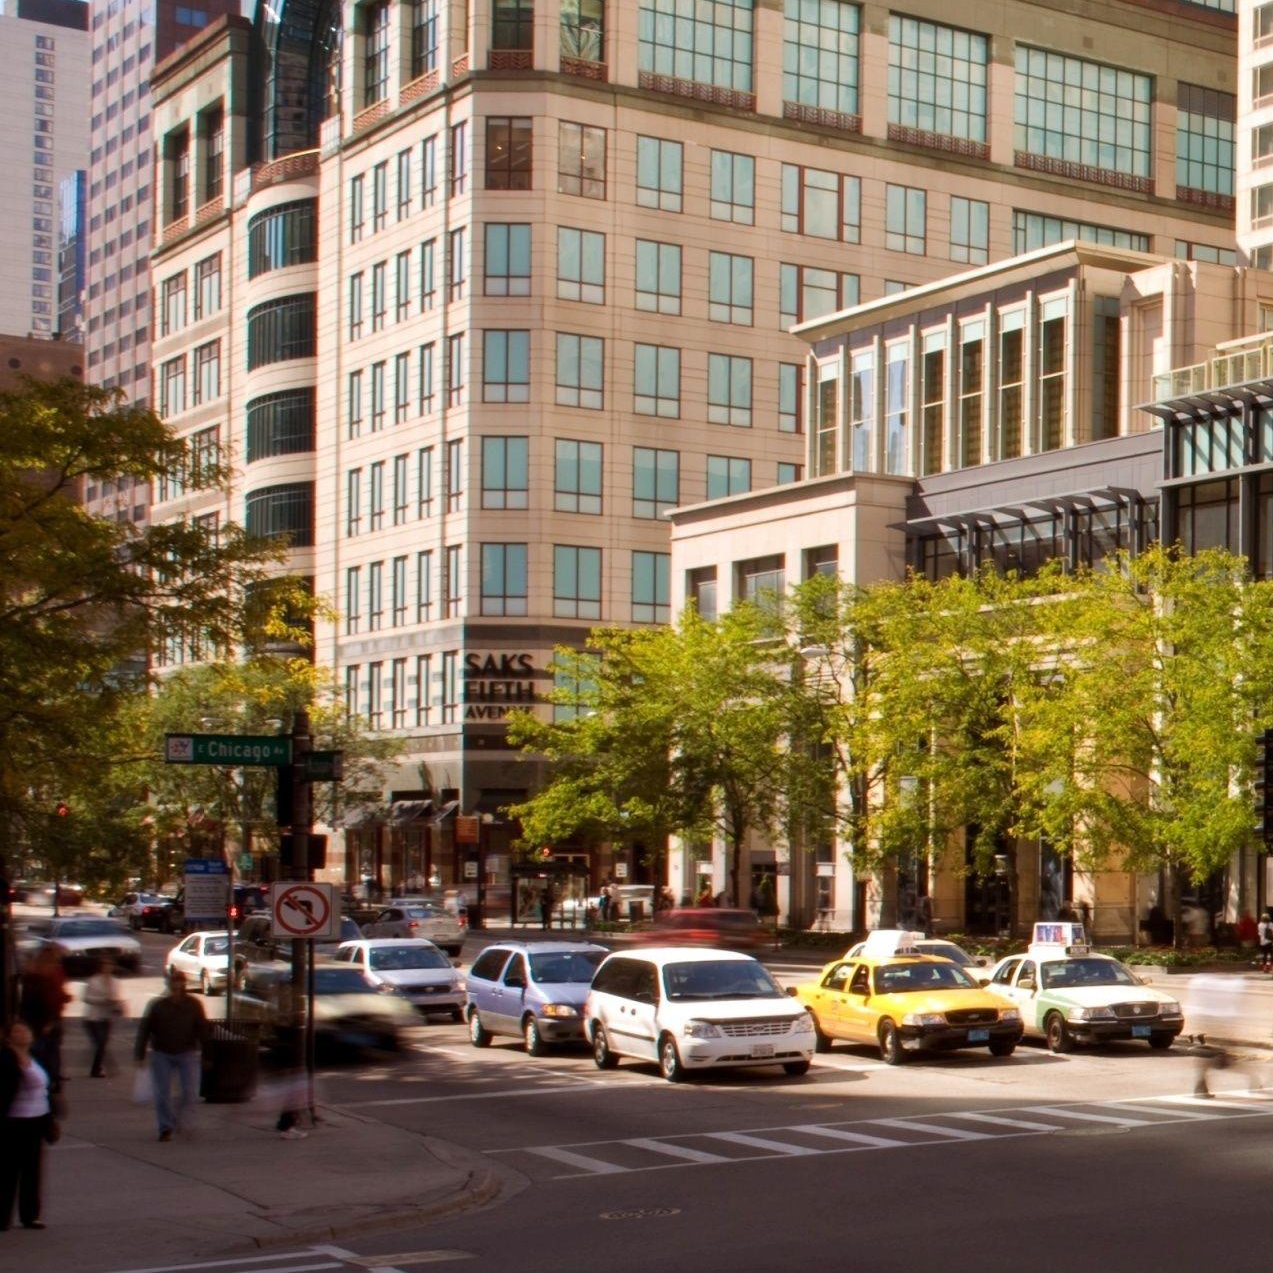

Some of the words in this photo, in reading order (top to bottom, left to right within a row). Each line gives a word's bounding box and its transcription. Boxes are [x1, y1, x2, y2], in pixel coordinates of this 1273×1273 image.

[465, 653, 534, 675] SAKS
[465, 681, 535, 701] FIFTH
[208, 741, 271, 762] Chicago
